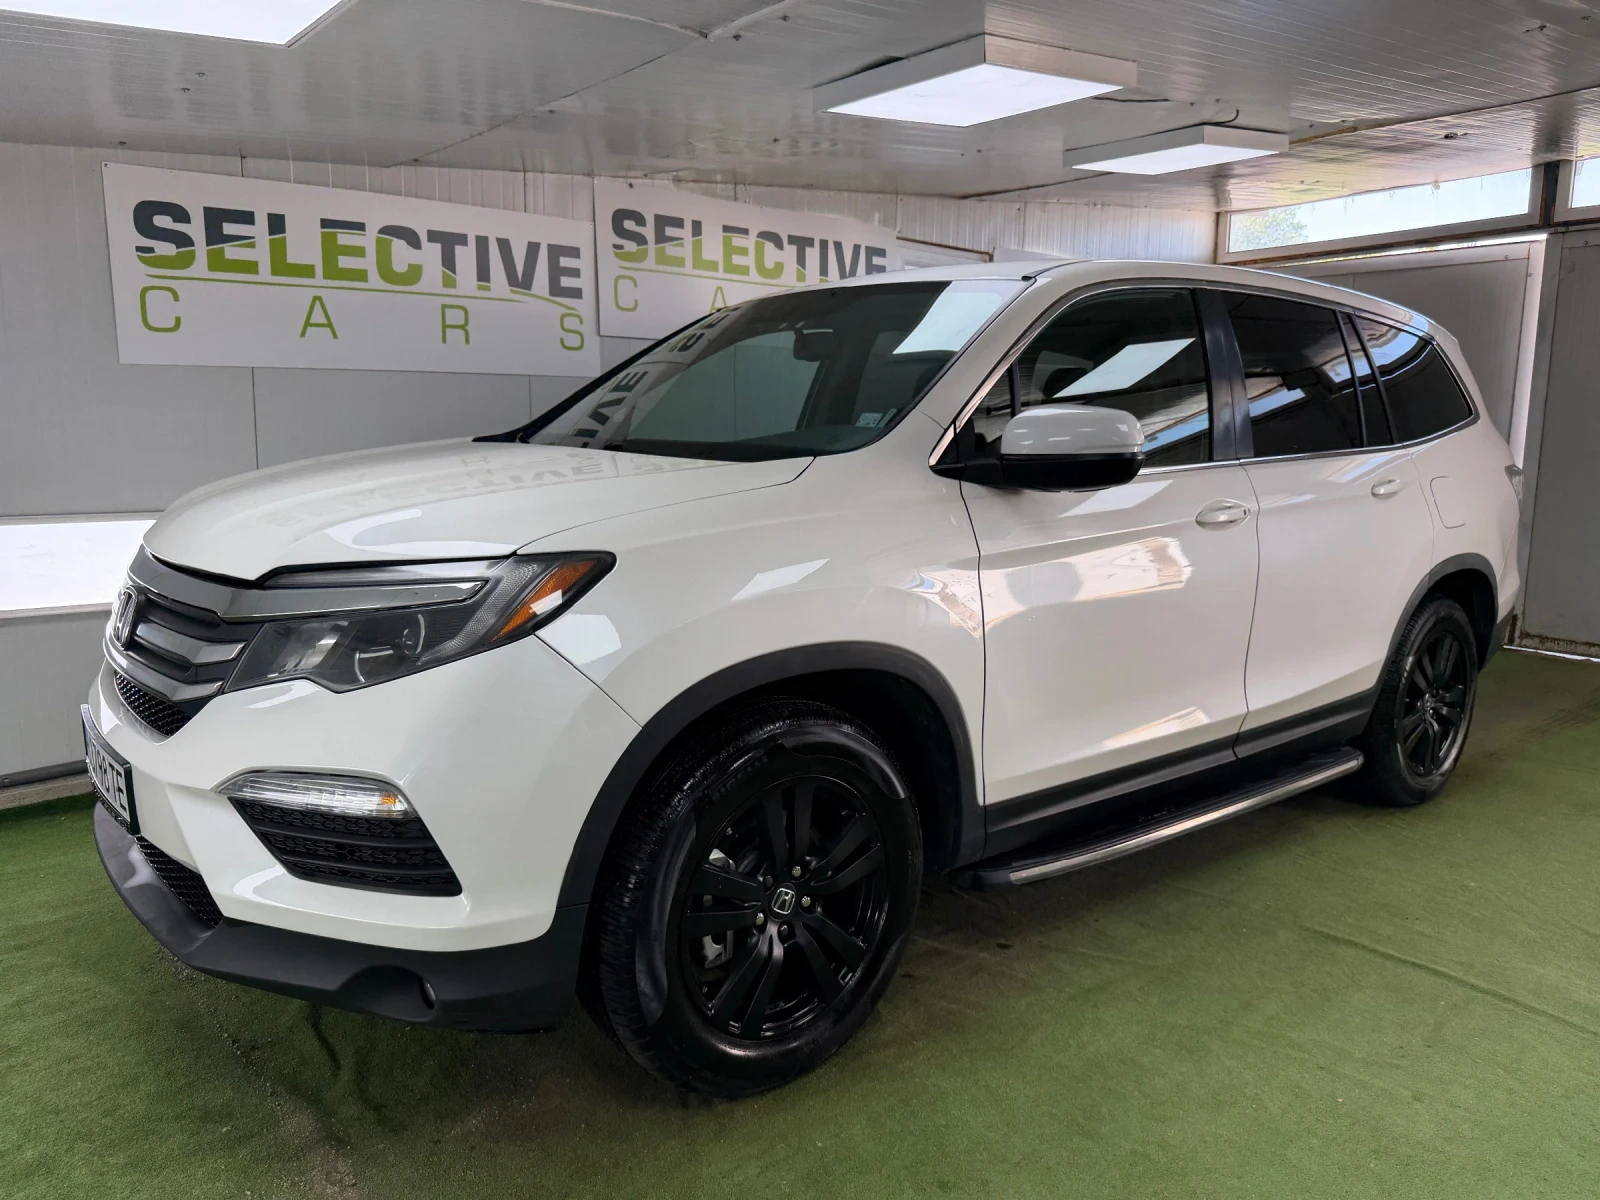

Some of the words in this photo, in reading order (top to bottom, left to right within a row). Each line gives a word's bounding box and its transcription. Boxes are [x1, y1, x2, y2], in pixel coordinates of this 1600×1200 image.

[132, 199, 583, 300] SELECTIVE
[611, 208, 887, 283] SELECTIVE
[139, 285, 585, 352] CARS
